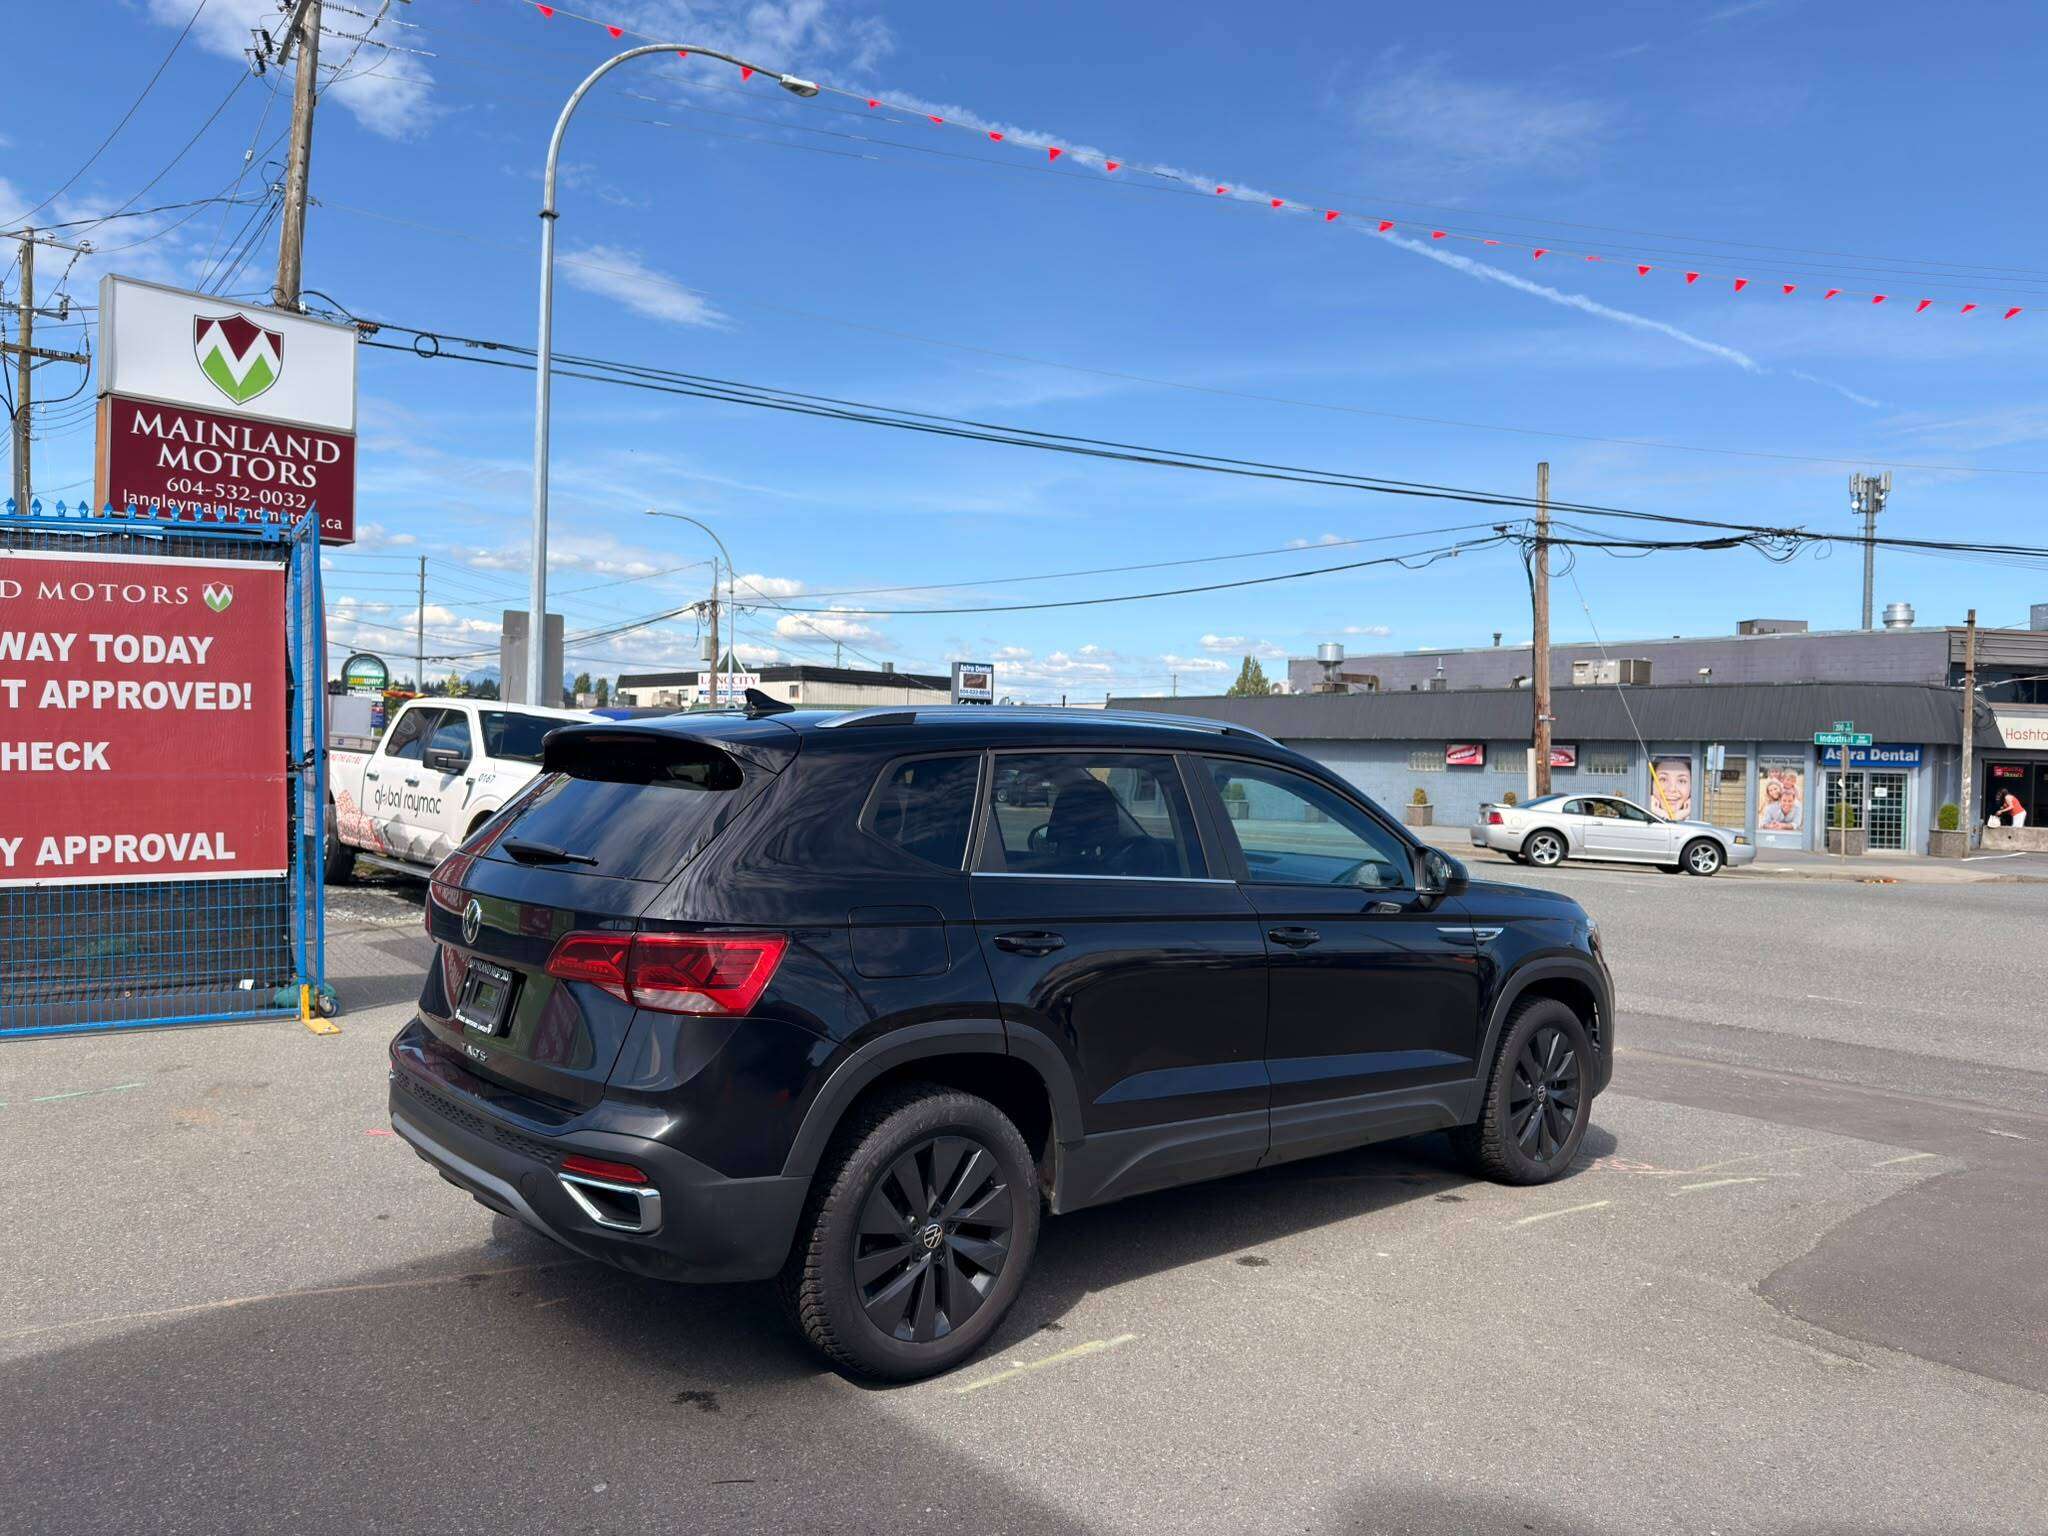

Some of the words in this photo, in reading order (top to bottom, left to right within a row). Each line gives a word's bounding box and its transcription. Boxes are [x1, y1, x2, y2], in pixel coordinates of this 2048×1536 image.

[129, 410, 341, 464] MAINLAND
[156, 444, 317, 489] MOTORS
[166, 477, 307, 509] 604-532-0032
[38, 581, 189, 605] MOTORS
[89, 633, 214, 665] TODAY
[1, 679, 27, 709] T
[38, 680, 252, 710] APPROVED!
[1, 741, 111, 771] HECK
[1825, 747, 1866, 761] Asra
[1870, 749, 1919, 762] Dental
[403, 793, 442, 818] raymac
[35, 832, 236, 866] APPROVAL
